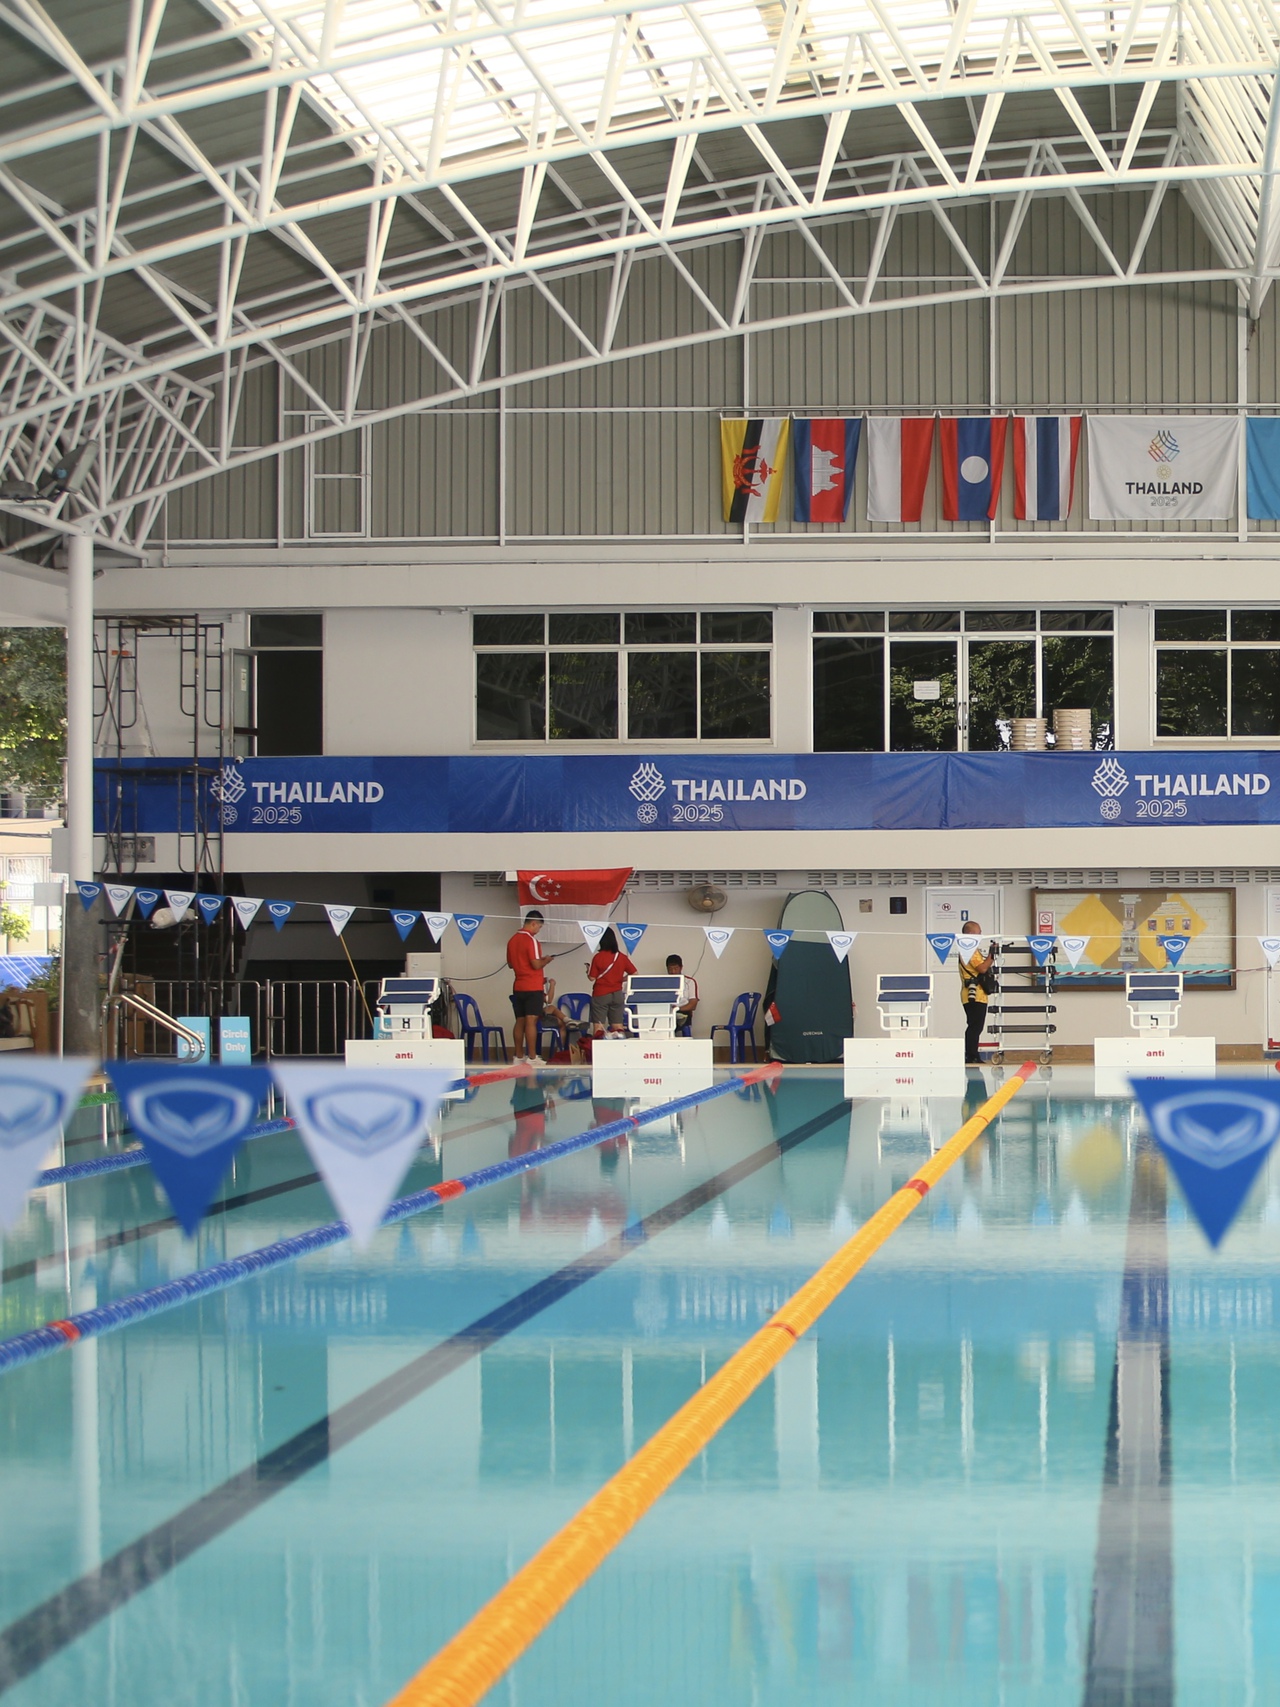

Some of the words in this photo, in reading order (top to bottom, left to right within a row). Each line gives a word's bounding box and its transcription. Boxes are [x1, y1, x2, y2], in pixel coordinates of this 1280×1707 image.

[1125, 482, 1203, 495] THAILAND
[1150, 496, 1178, 507] 2025
[672, 778, 807, 802] THAILAND
[1135, 773, 1271, 797] THAILAND
[252, 781, 384, 803] THAILAND
[251, 806, 302, 824] 2025
[672, 804, 724, 823] 2025
[1136, 799, 1188, 818] 2025
[222, 1030, 248, 1039] Circle
[225, 1043, 246, 1053] Only
[895, 1050, 914, 1058] anti
[1146, 1049, 1165, 1057] anti
[643, 1051, 662, 1059] anti
